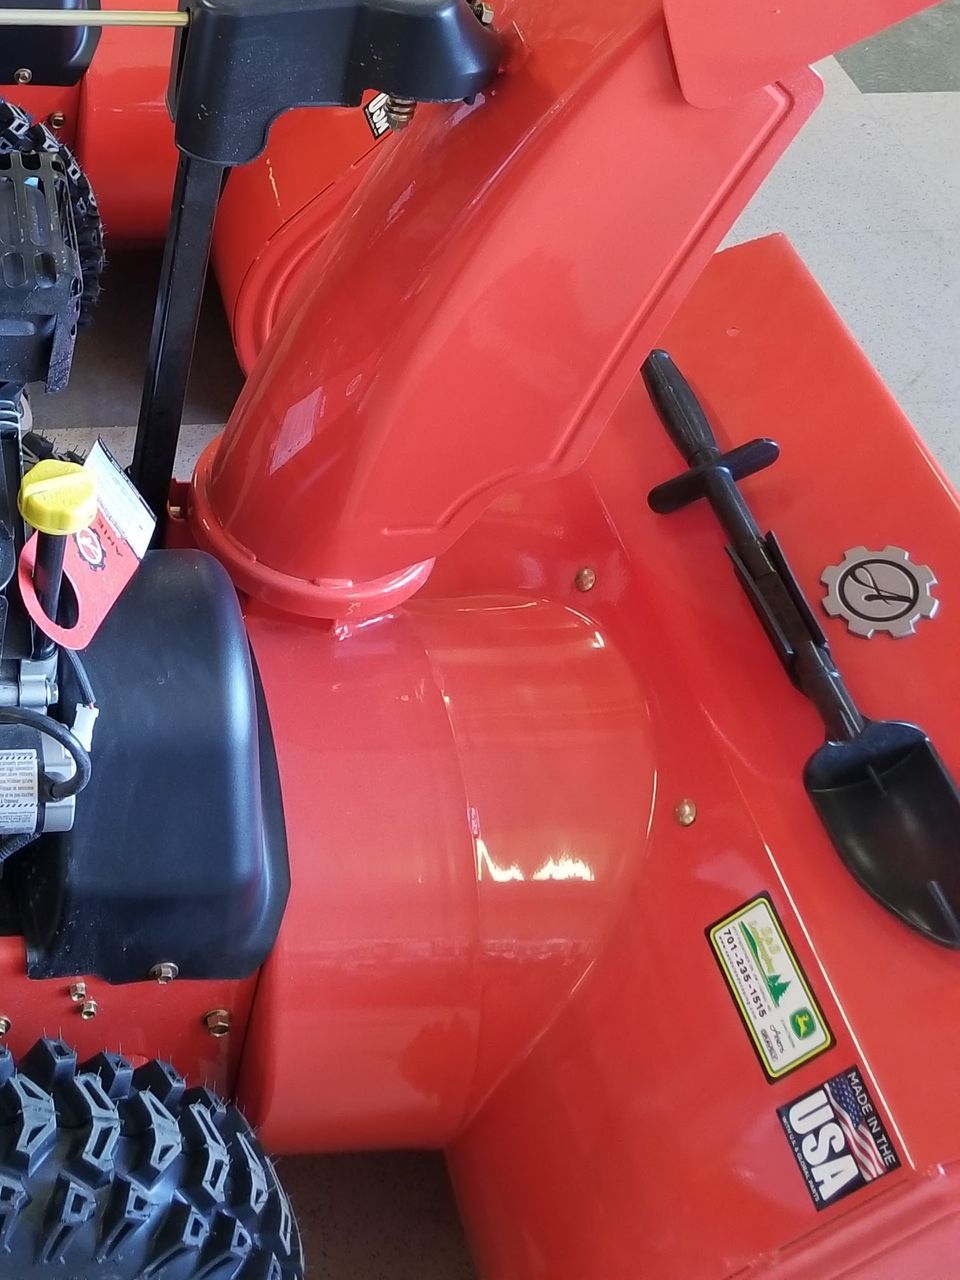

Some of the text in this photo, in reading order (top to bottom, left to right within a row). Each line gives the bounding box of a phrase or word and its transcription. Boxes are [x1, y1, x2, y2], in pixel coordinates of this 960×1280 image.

[788, 1088, 860, 1202] USA
[847, 1070, 896, 1167] MADE IN THE
